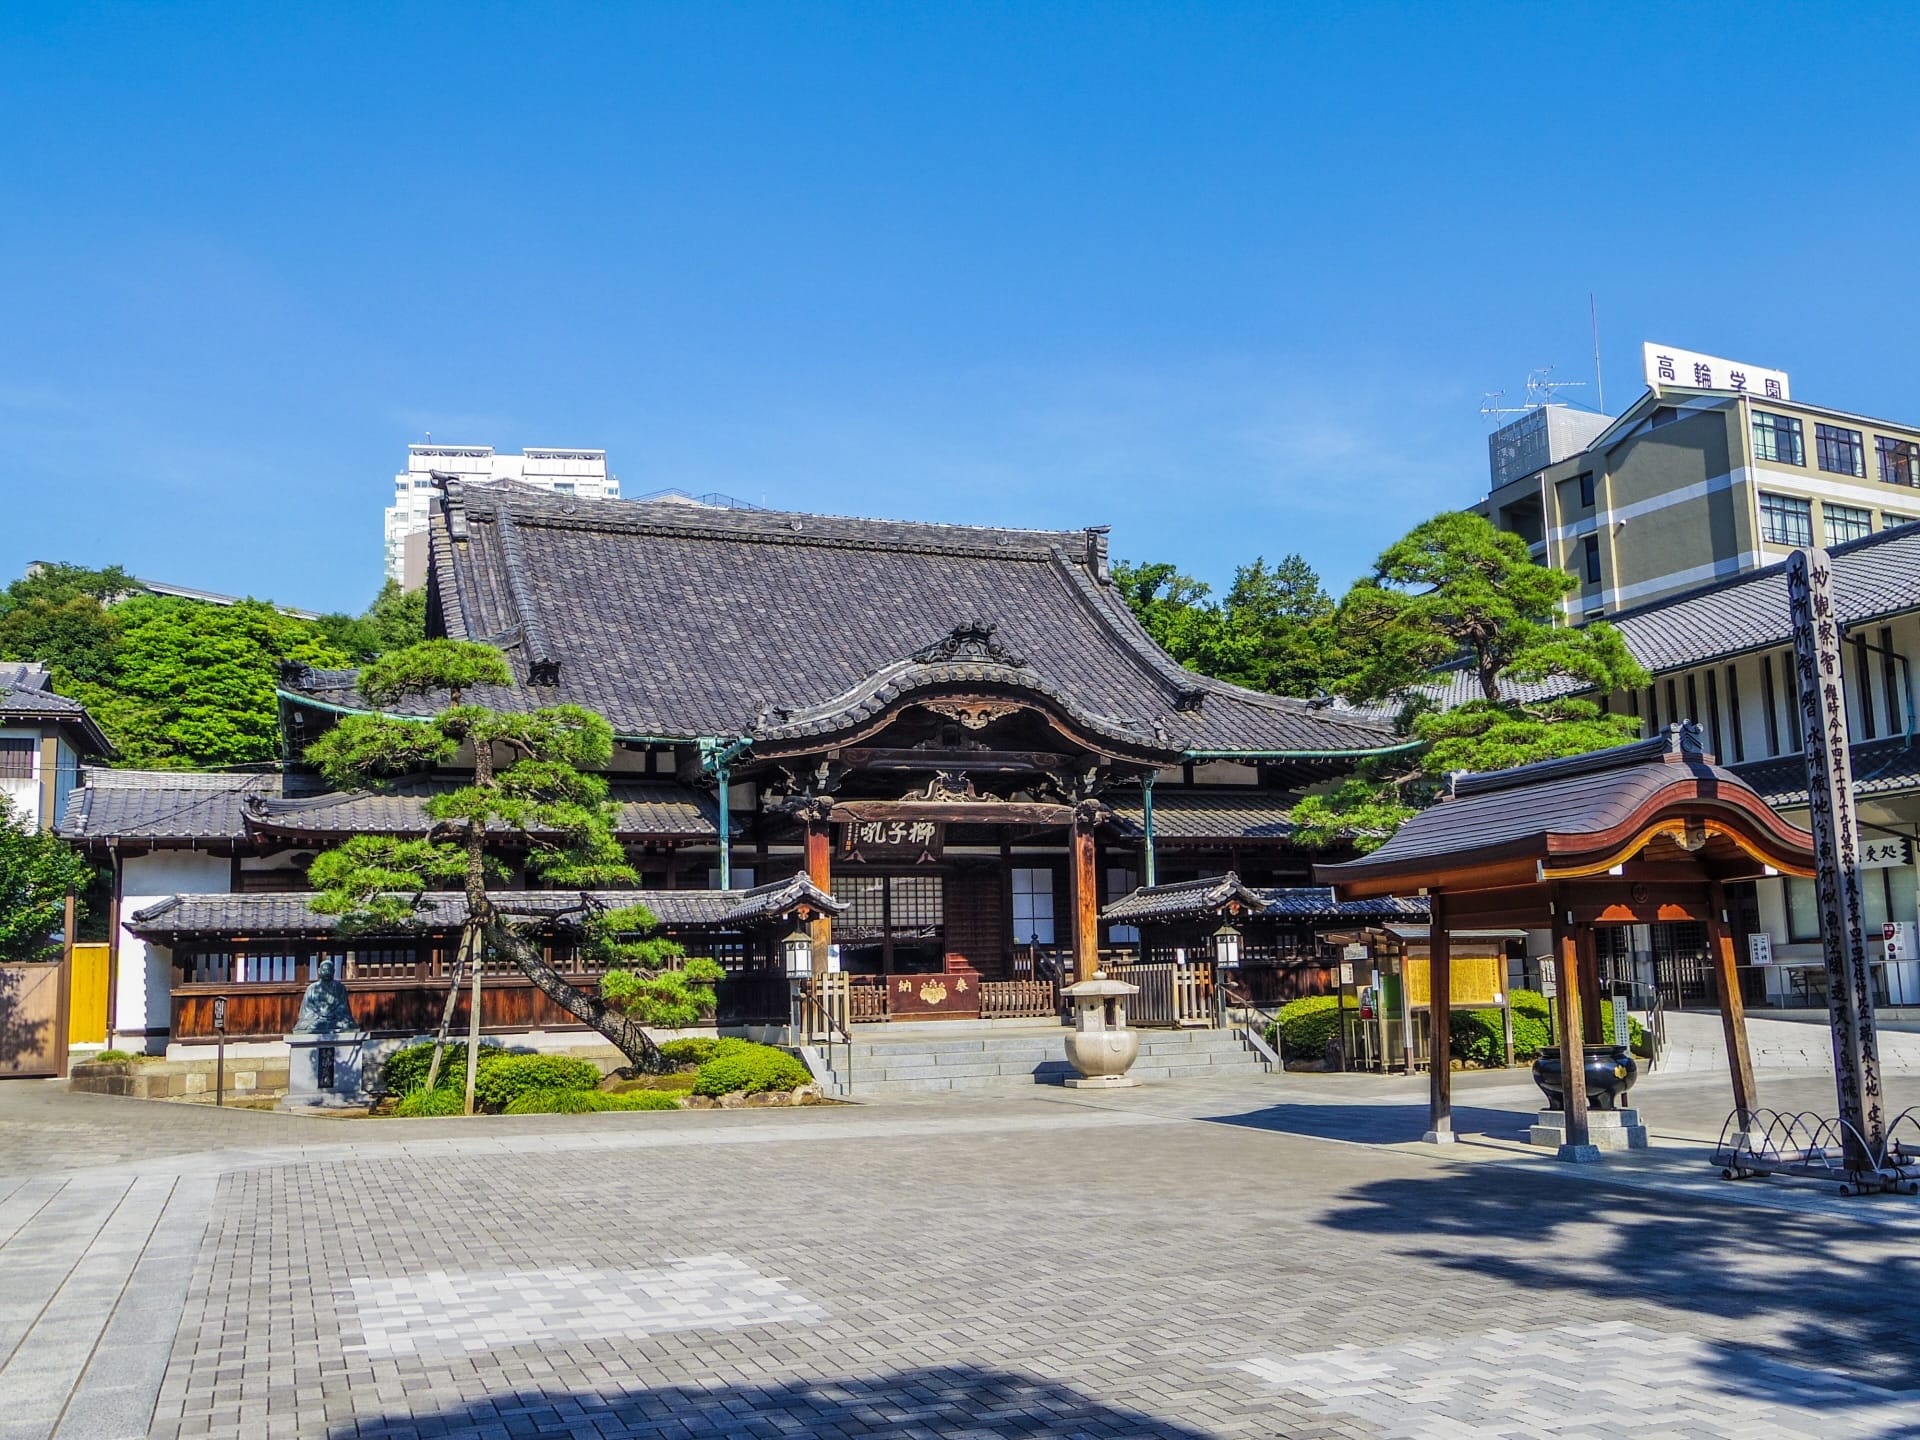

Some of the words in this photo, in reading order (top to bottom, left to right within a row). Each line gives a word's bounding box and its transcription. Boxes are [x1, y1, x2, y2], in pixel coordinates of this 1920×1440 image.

[1656, 355, 1782, 400] 高輪学園
[1859, 845, 1897, 862] 受処
